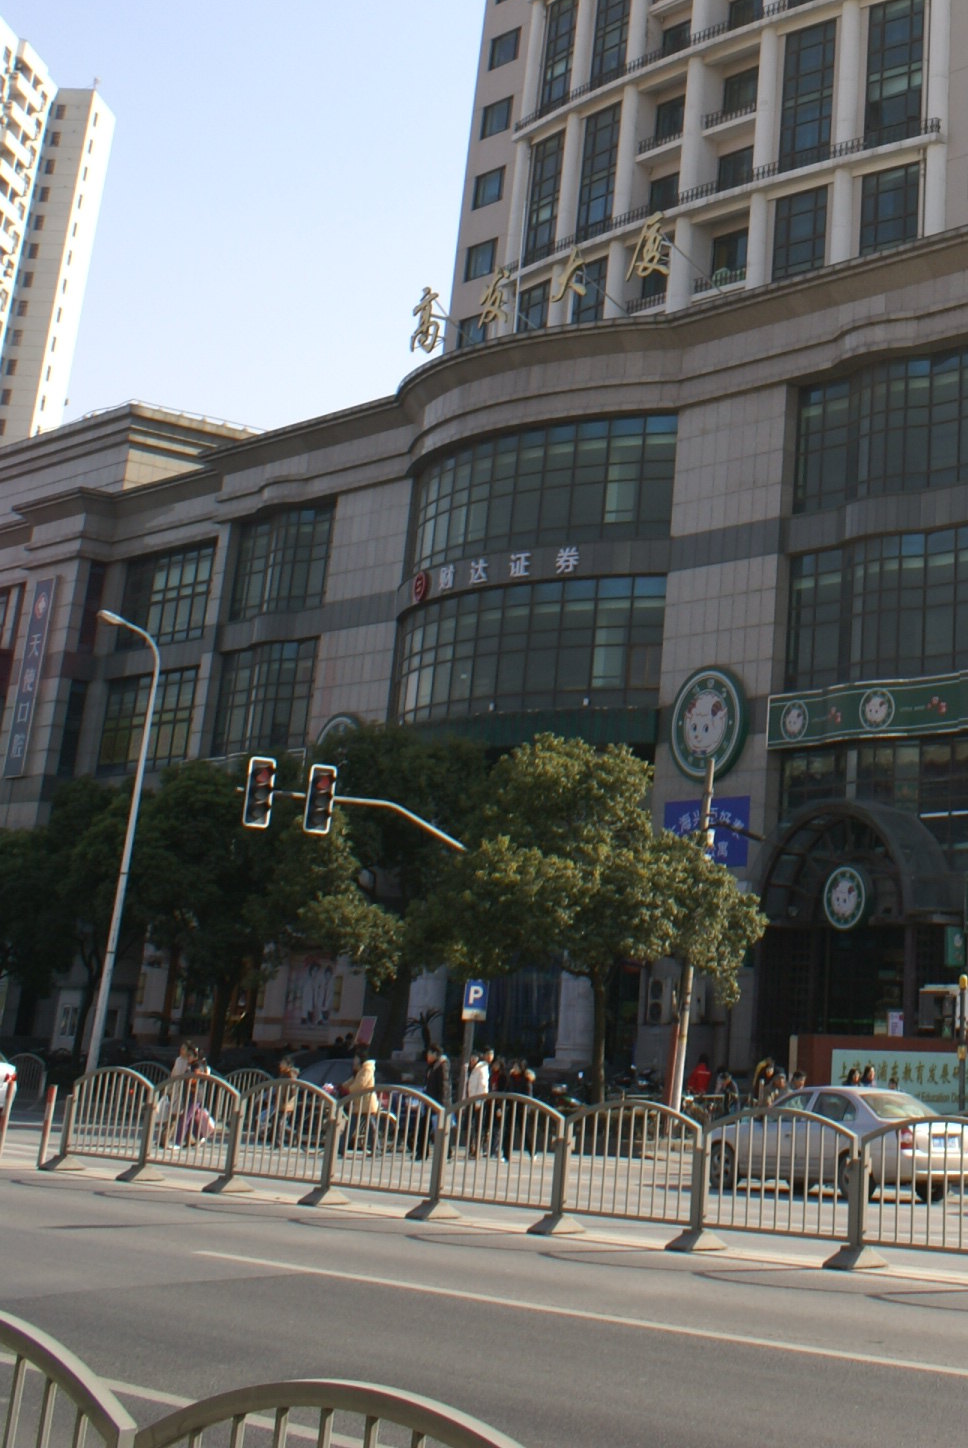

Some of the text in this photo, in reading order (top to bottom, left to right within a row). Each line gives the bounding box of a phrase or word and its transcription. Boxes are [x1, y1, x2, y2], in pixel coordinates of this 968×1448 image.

[438, 546, 581, 591] 财达证券
[11, 633, 41, 758] 天使口腔
[468, 985, 484, 1005] P
